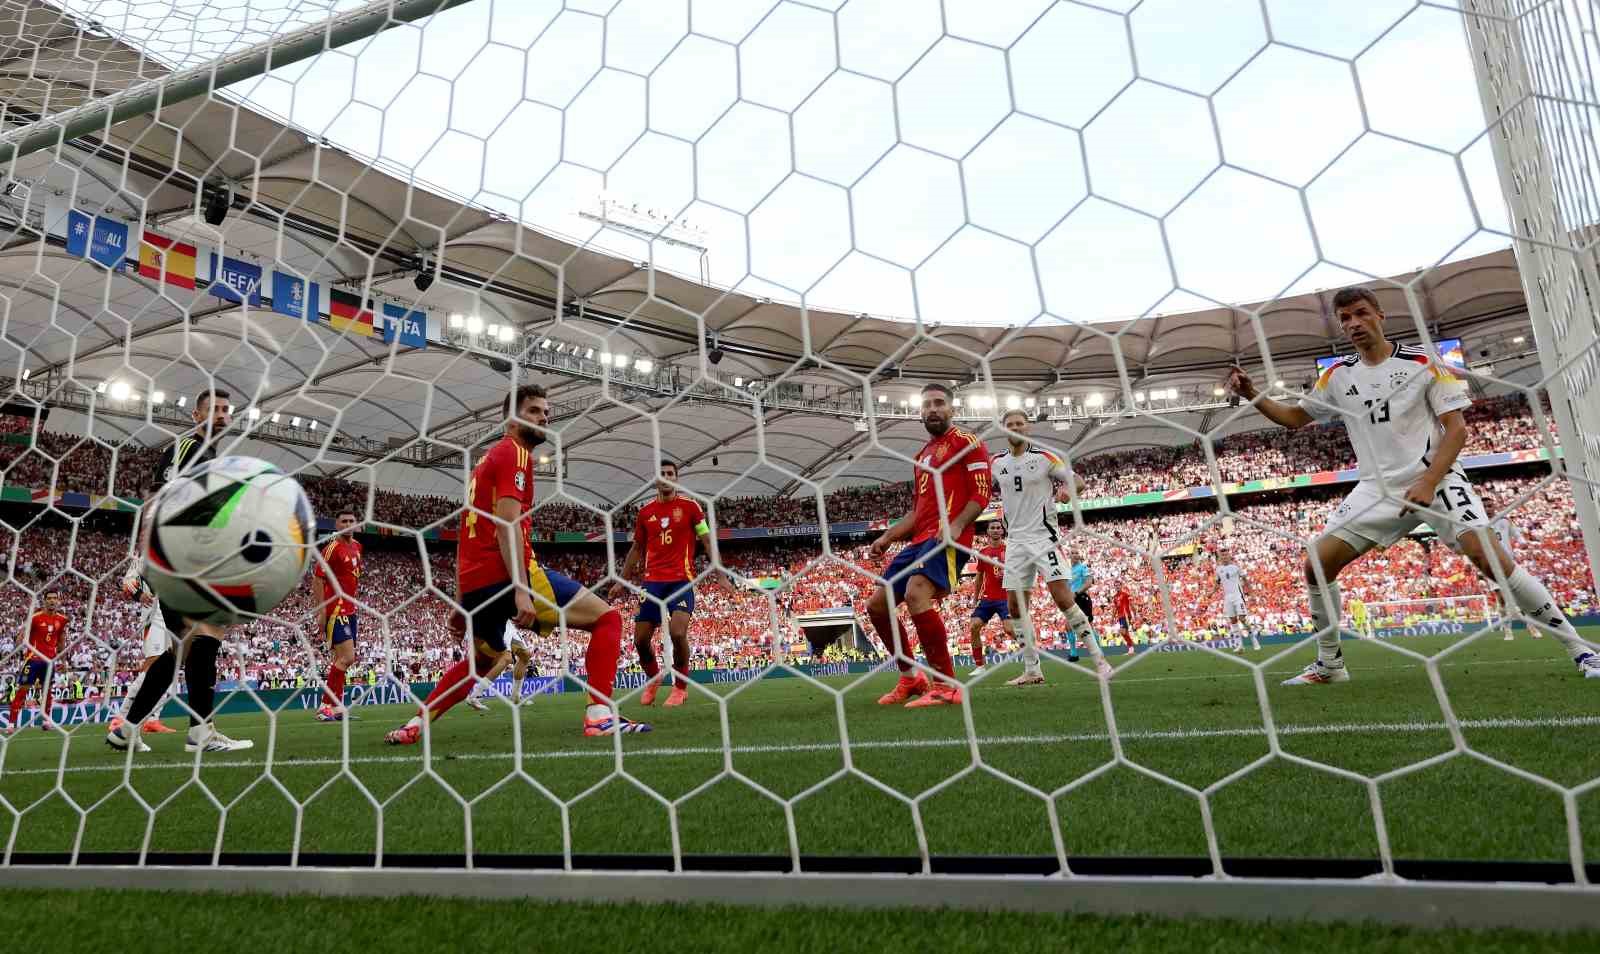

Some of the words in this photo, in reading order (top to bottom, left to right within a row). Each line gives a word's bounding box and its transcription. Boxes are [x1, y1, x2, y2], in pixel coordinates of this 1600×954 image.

[1364, 398, 1390, 425] 13
[920, 472, 929, 494] 2
[1014, 475, 1023, 492] 9
[1436, 486, 1472, 511] 13
[659, 529, 673, 546] 16
[1047, 551, 1059, 566] 9
[23, 665, 31, 674] 6
[523, 680, 547, 695] 2024
[613, 671, 648, 689] ATAR
[50, 696, 126, 727] QATA
